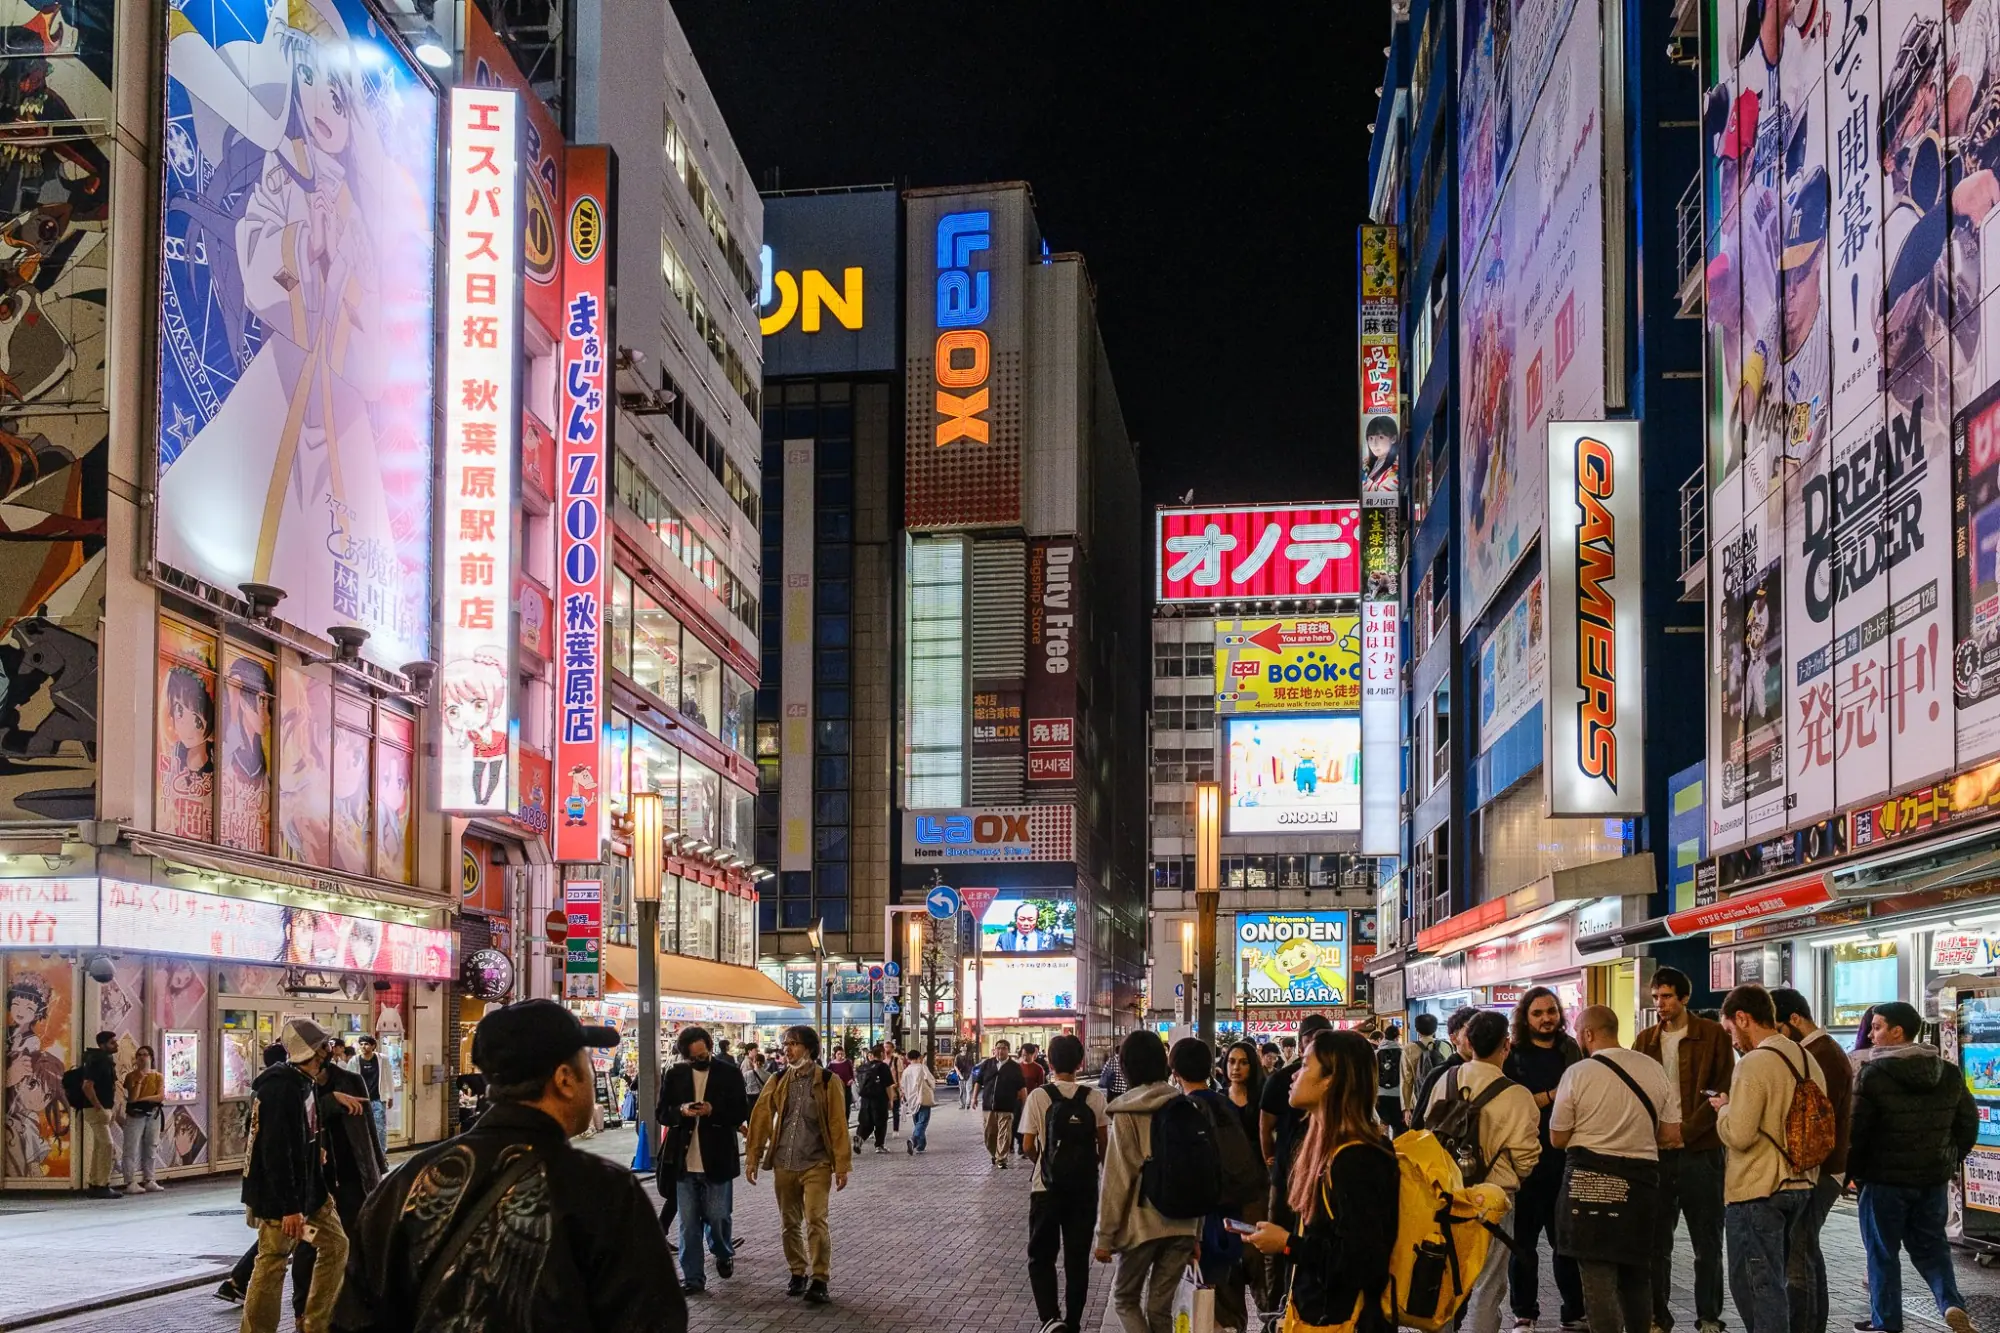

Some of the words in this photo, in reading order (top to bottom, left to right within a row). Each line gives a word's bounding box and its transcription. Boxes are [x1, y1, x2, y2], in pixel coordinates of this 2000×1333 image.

[462, 103, 501, 349] エスパス日拓
[578, 207, 593, 255] ZOO
[1363, 318, 1397, 334] 麻雀
[565, 293, 602, 444] まぁじゃん
[1802, 393, 1925, 557] DREAM
[458, 378, 499, 630] 秋葉原駅前店
[564, 455, 602, 586] ZOO
[1166, 510, 1360, 586] オノデ
[1722, 523, 1759, 575] DREAM
[1805, 488, 1925, 624] ORDER
[1030, 547, 1044, 604] Flagship
[1043, 546, 1074, 609] Duty
[1573, 436, 1619, 796] GAMERS
[1031, 607, 1044, 645] Store
[1296, 622, 1330, 634] 現在地
[1045, 614, 1074, 674] Free
[1282, 634, 1296, 642] You
[1312, 634, 1332, 642] here
[563, 592, 599, 745] 秋葉原店
[1233, 663, 1259, 675] ここ!
[974, 694, 997, 706] 本店
[1273, 684, 1360, 700] 現在地から徒歩
[1797, 622, 1940, 777] 発売中!
[788, 704, 807, 717] 4F
[1286, 700, 1303, 708] walk
[1304, 700, 1322, 708] from
[1032, 723, 1070, 742] 免税
[1031, 757, 1071, 773] 면세점
[1277, 811, 1338, 824] ONODEN
[914, 848, 943, 857] Home
[945, 847, 1001, 857] Electronics
[1003, 846, 1032, 856] Store
[319, 880, 340, 892] ESPACE
[567, 890, 600, 900] フロア案内
[967, 891, 991, 900] 止まれ
[971, 901, 988, 909] STOP
[0, 909, 57, 943] 0台
[1240, 922, 1343, 942] ONODEN
[467, 951, 507, 970] SMOKER'S
[567, 951, 588, 962] 禁煙
[1320, 947, 1341, 967] 迎
[1936, 950, 1975, 966] カードゲーム
[796, 972, 817, 998] 酒
[1496, 992, 1515, 1000] TCG
[1280, 1009, 1298, 1019] TAX
[1325, 1008, 1345, 1019] 免税
[1248, 1021, 1287, 1031] オノデン
